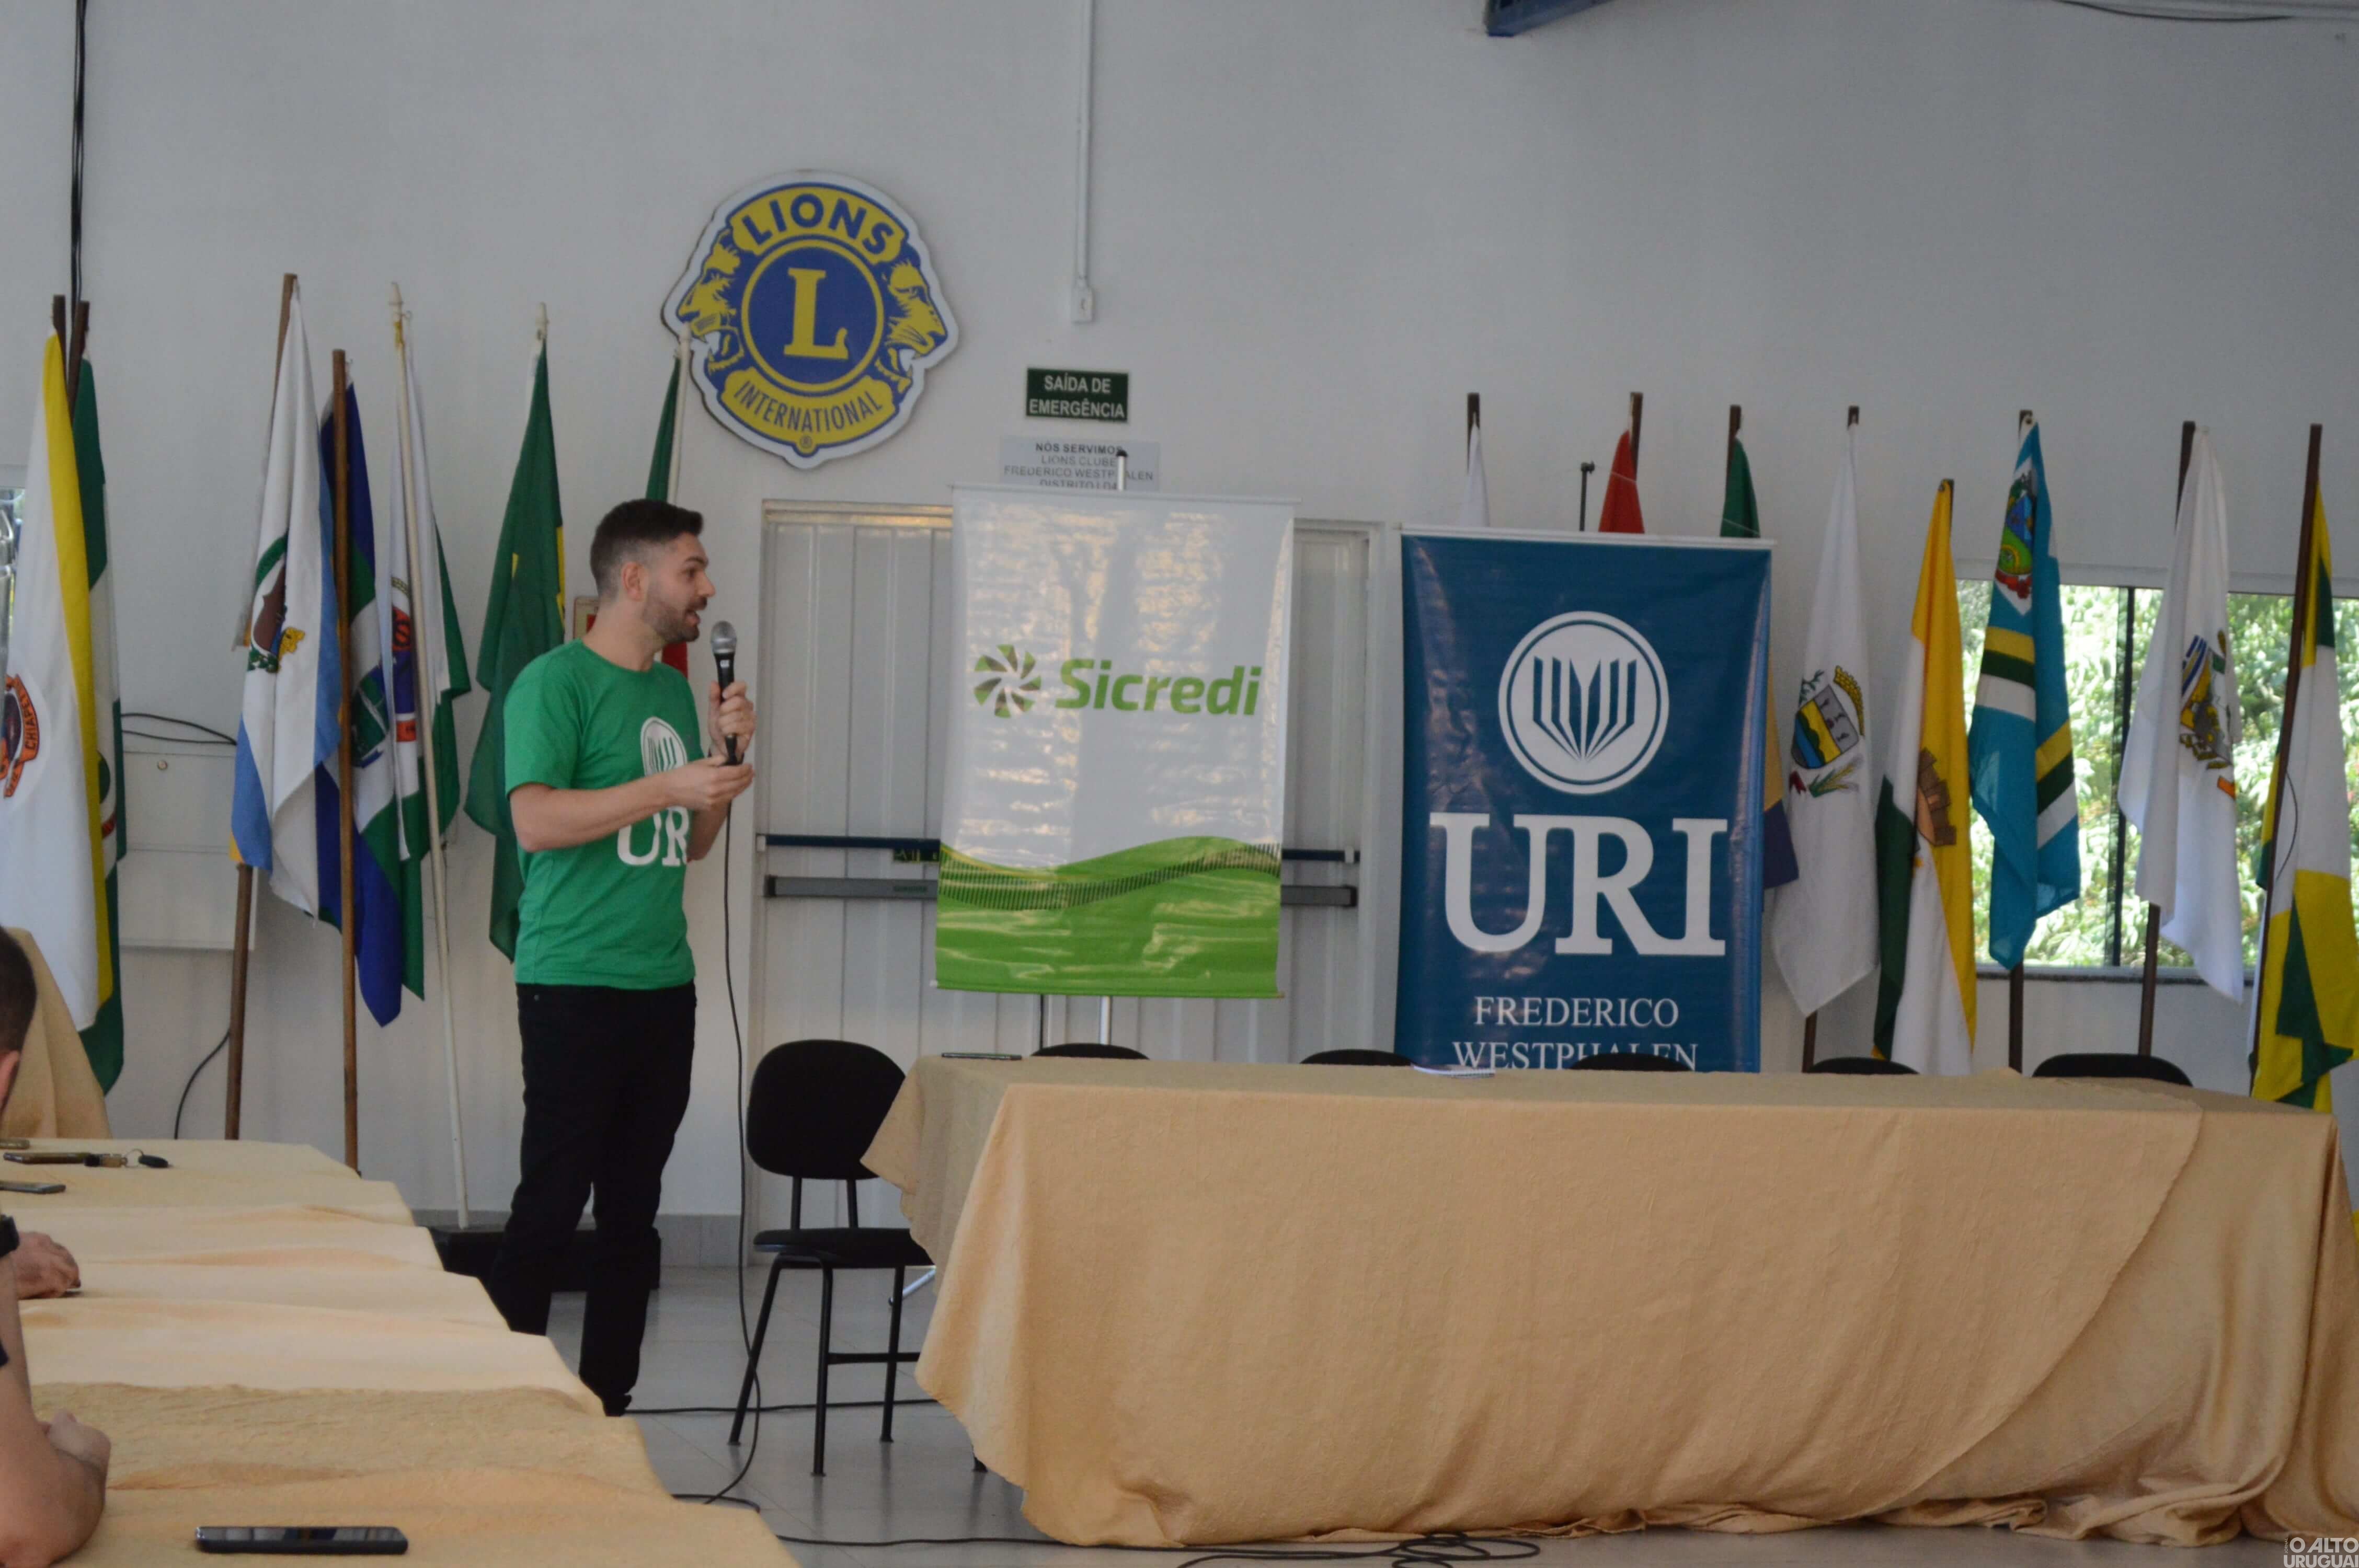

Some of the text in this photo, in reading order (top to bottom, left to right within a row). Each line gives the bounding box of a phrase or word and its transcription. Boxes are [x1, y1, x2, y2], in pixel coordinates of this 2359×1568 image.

[741, 193, 894, 255] LIONS
[784, 267, 849, 360] L
[1044, 372, 1111, 394] SAÍDA DE
[734, 380, 883, 433] INTERNATIONAL
[1029, 398, 1125, 418] EMERGÊNCIA
[1004, 465, 1153, 481] FREDERICO WESTPALEN
[1041, 455, 1117, 467] LIONS CLUBE
[1055, 659, 1262, 716] Sicredi
[1430, 812, 1727, 956] URI
[1473, 996, 1679, 1028] FREDERICO
